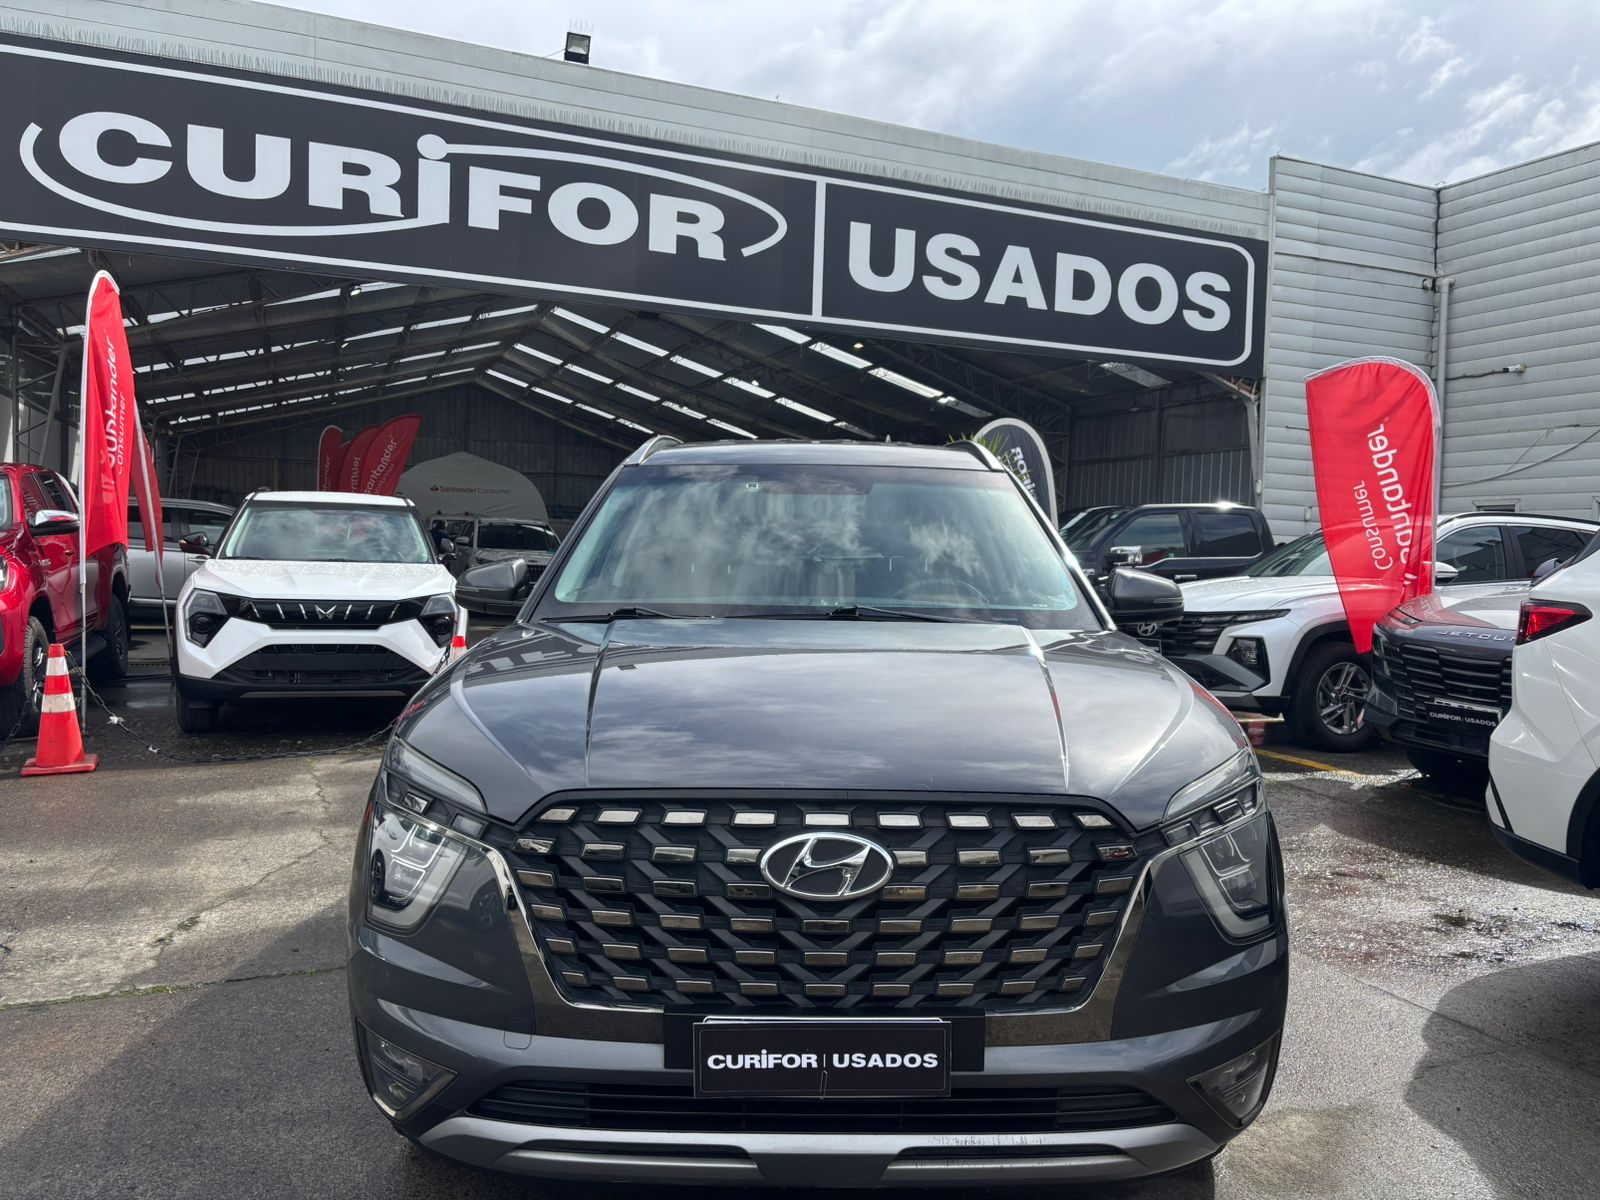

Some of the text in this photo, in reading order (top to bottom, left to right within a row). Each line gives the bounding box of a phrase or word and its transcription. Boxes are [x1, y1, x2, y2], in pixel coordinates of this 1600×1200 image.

[848, 222, 1230, 332] USADOS
[440, 485, 477, 494] Santander
[1464, 716, 1497, 727] USADOS
[832, 1053, 938, 1068] USADOS
